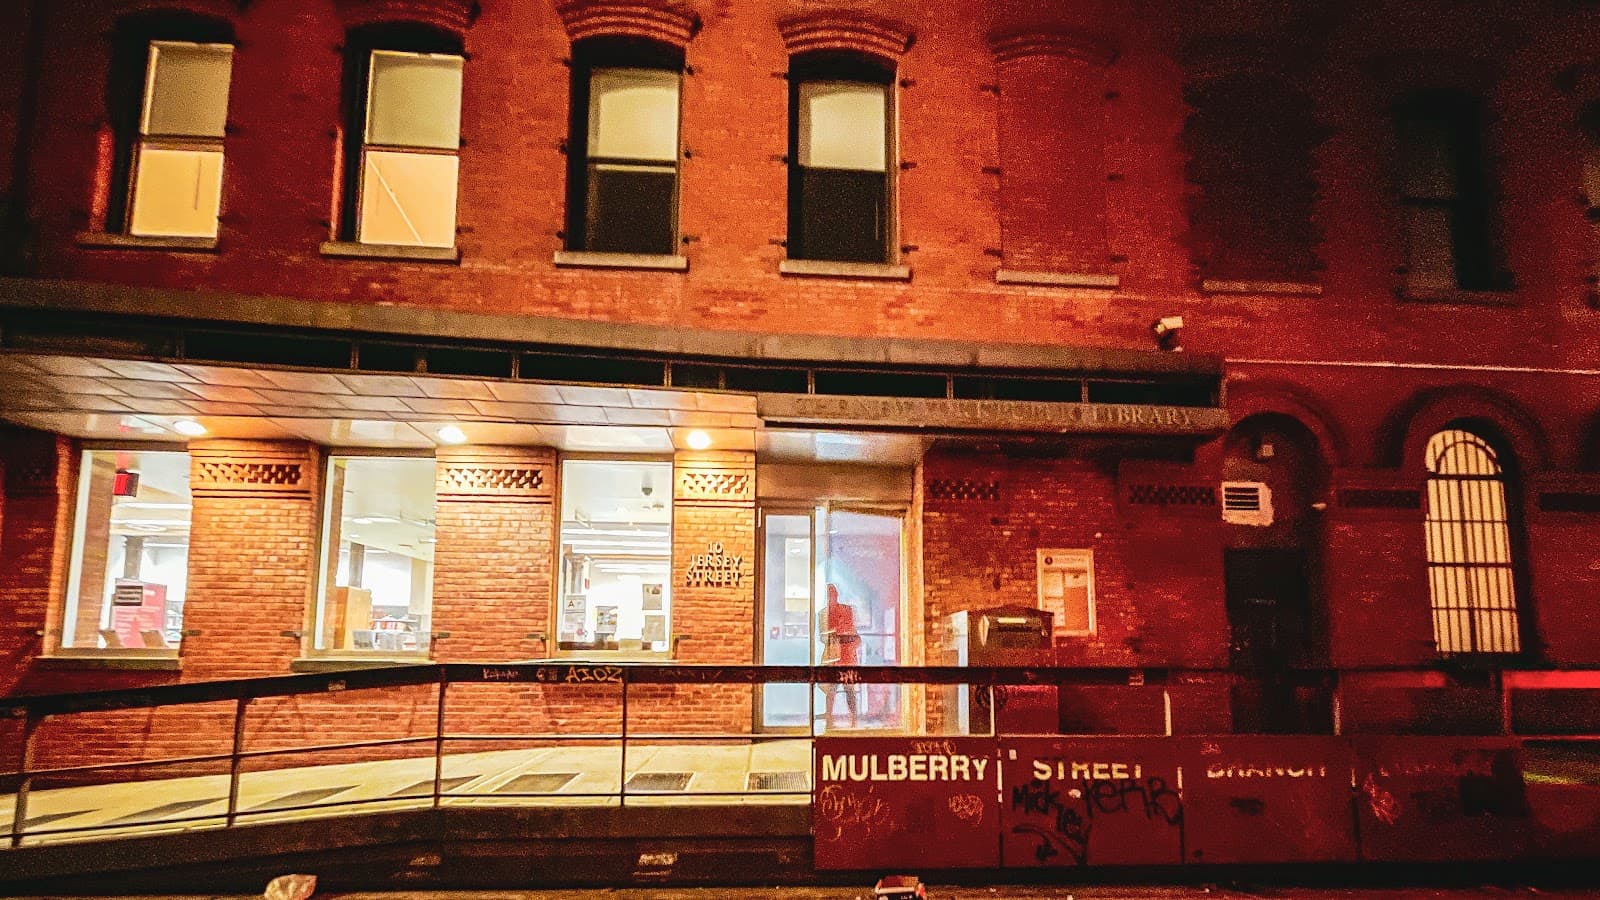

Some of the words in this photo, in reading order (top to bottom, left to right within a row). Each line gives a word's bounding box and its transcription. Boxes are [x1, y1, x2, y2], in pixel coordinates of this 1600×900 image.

[1092, 406, 1192, 425] LIBRARY
[690, 554, 742, 570] JERSEY
[686, 571, 741, 583] STREET
[822, 754, 988, 781] MULBERRY
[1033, 757, 1142, 780] STREET
